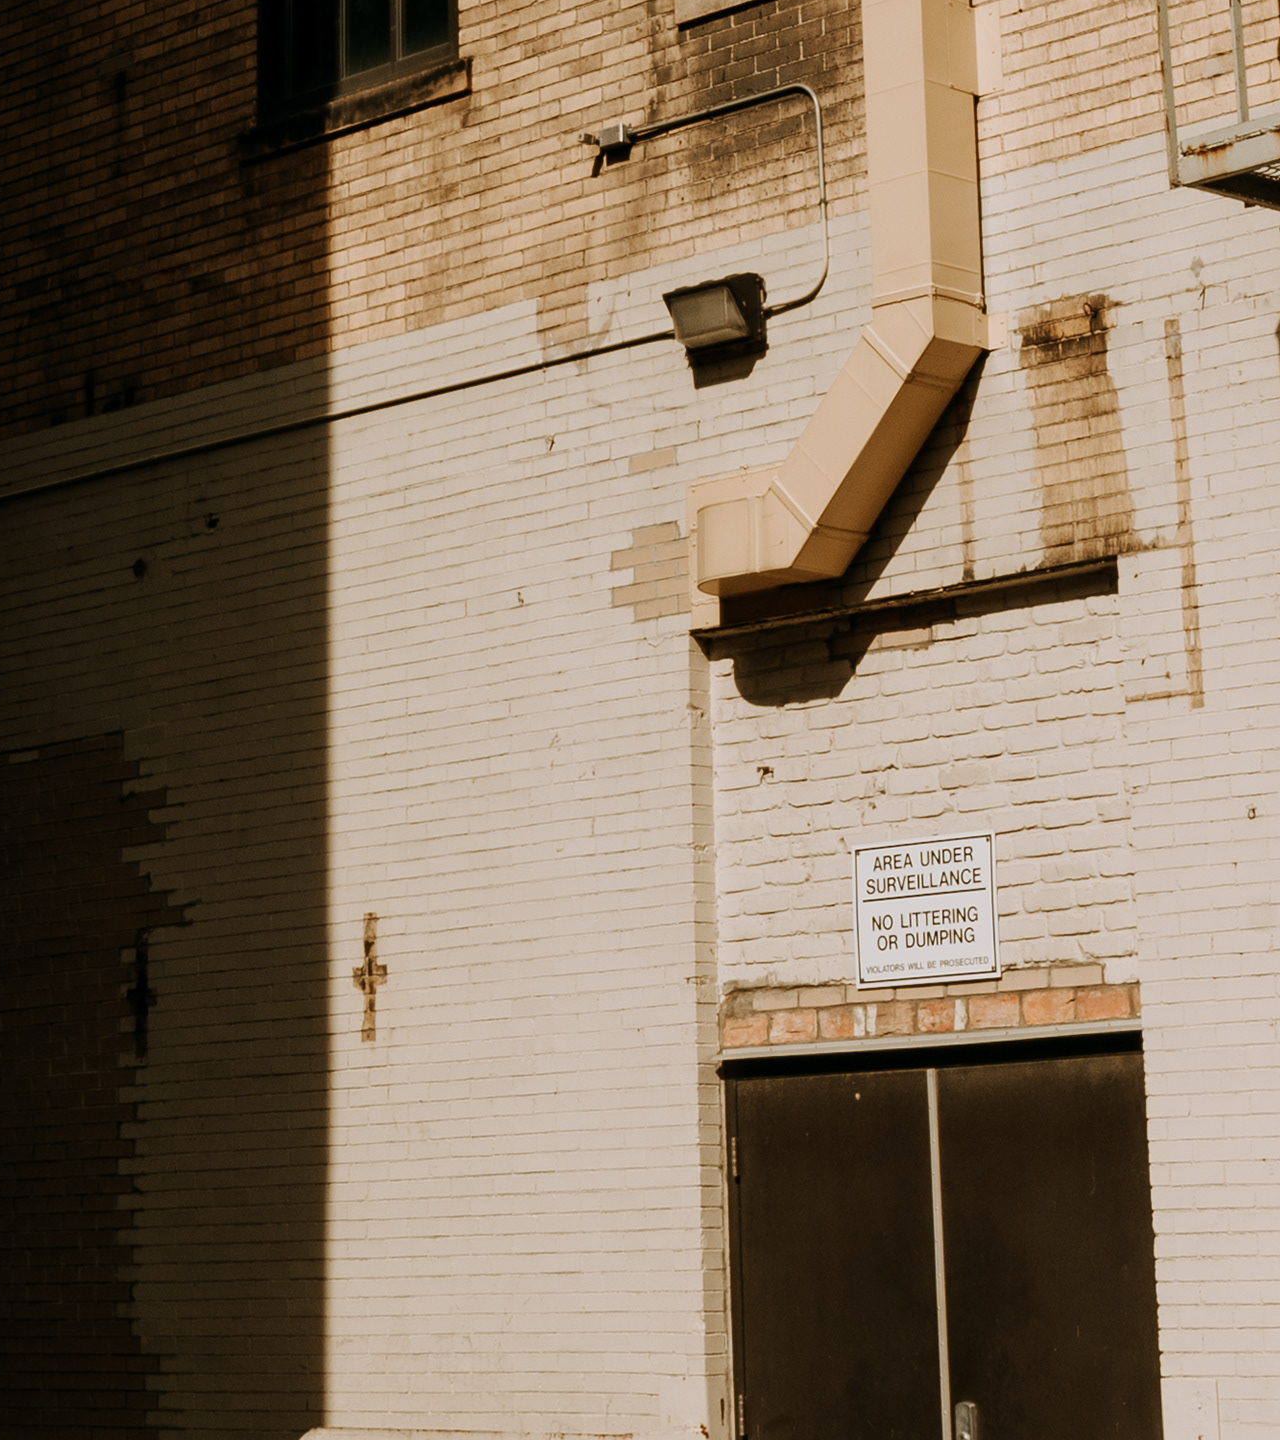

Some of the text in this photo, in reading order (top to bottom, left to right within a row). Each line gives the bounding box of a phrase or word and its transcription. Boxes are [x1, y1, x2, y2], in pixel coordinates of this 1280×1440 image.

[873, 846, 973, 872] AREA UNDER
[866, 868, 982, 894] SURVEILLANCE
[872, 906, 978, 931] NO LITTERING
[877, 927, 976, 951] OR DUMPING
[866, 956, 990, 974] VIOLATORS WILL BE PROSECUTED
